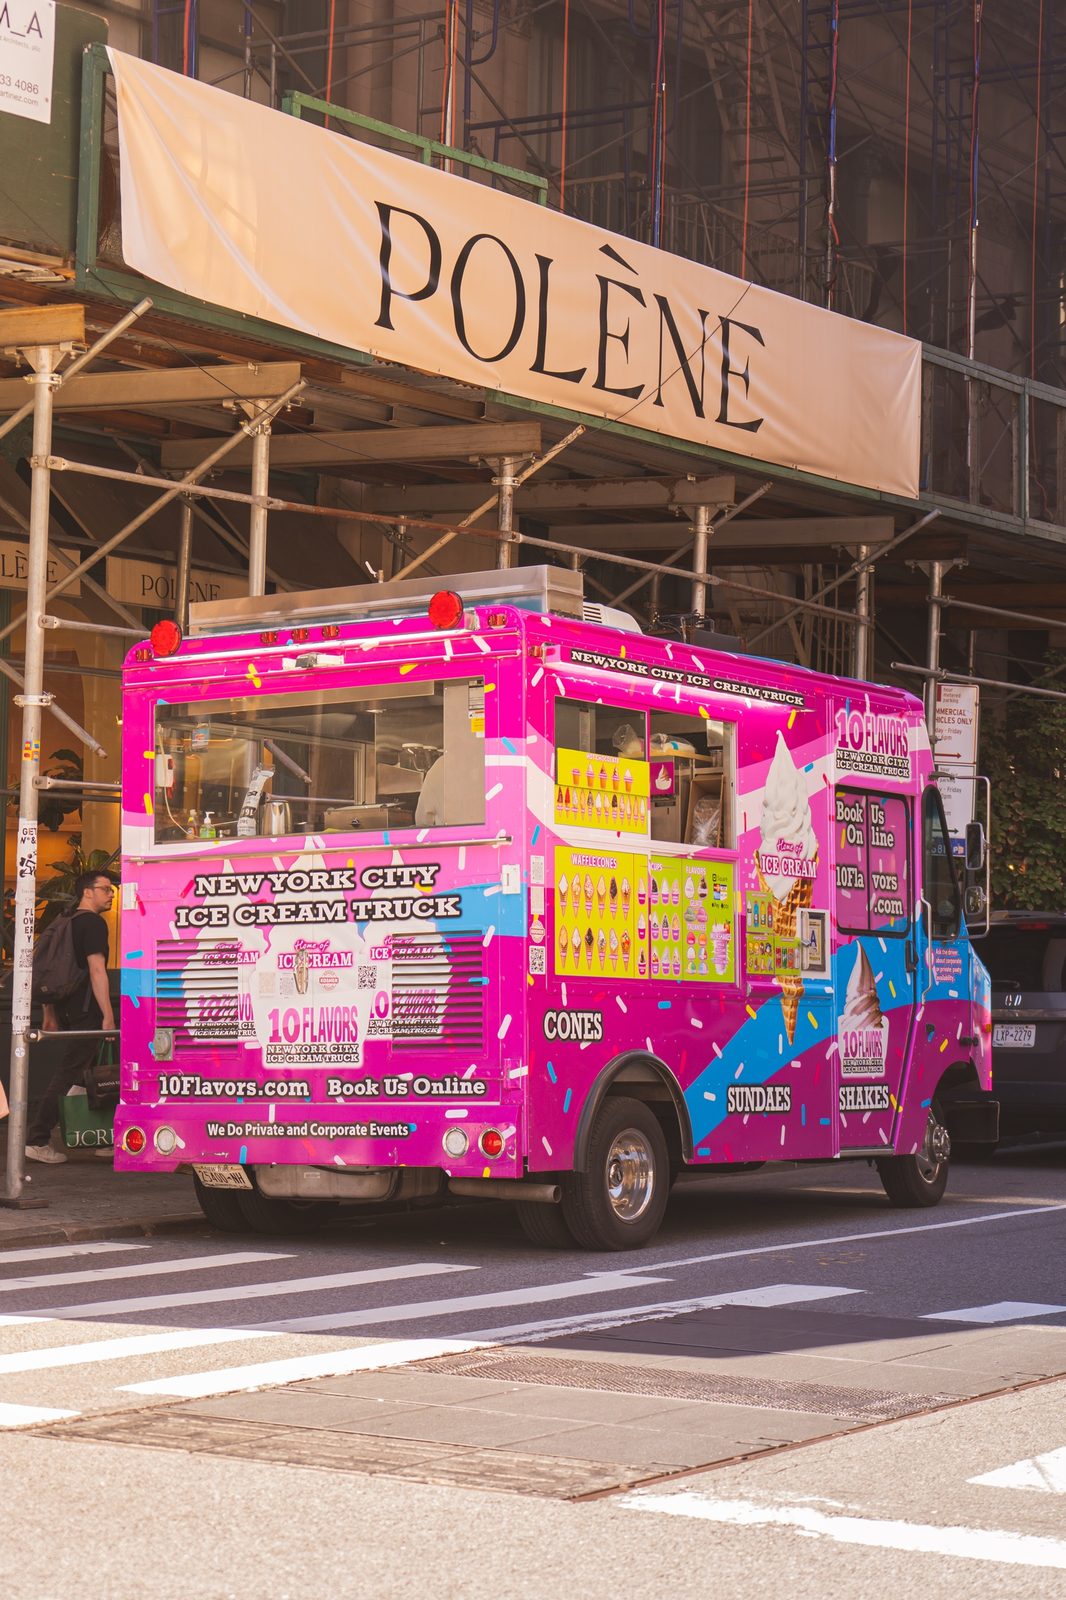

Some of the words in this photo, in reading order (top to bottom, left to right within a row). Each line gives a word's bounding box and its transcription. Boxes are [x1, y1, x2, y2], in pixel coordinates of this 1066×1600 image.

[15, 79, 39, 95] 4086
[374, 201, 765, 433] POLÈNE
[1, 550, 58, 584] LÈE
[141, 574, 221, 602] POLNE
[571, 651, 605, 665] NEW
[607, 658, 648, 674] YORK
[651, 668, 684, 681] CITY
[687, 675, 711, 687] ICE
[713, 680, 760, 697] CREAM
[762, 690, 804, 705] TRUCK
[957, 717, 973, 725] ONLY
[836, 712, 864, 751] 10
[864, 715, 909, 758] FLAVORS
[836, 760, 851, 769] ICE
[853, 762, 882, 773] CREAM
[883, 766, 909, 777] TRUCK
[837, 750, 858, 760] NEW
[860, 753, 885, 764] YORK
[887, 757, 909, 768] CITY
[836, 800, 864, 822] Book
[871, 804, 885, 825] Us
[847, 824, 864, 845] On
[871, 826, 894, 847] line
[571, 853, 597, 866] WAFFLE
[597, 856, 617, 869] CONES
[761, 856, 780, 874] ICE
[781, 857, 817, 878] CREAM
[195, 874, 265, 895] NEW
[266, 870, 355, 892] YORK
[361, 866, 439, 887] CITY
[836, 866, 864, 888] 10Fla
[872, 874, 898, 891] vors
[177, 907, 228, 926] ICE
[234, 902, 347, 924] CREAM
[352, 897, 461, 920] TRUCK
[874, 899, 903, 915] .com
[294, 939, 317, 950] Home
[319, 940, 330, 951] of
[811, 930, 817, 947] A
[307, 952, 353, 967] CREAM
[371, 948, 389, 959] ICE
[267, 1007, 301, 1043] 10
[302, 1005, 358, 1043] FLAVORS
[544, 1011, 603, 1040] CONES
[267, 1045, 292, 1054] NEW
[293, 1045, 327, 1054] YORK
[329, 1044, 359, 1053] CITY
[267, 1055, 285, 1063] ICE
[286, 1054, 321, 1062] CREAM
[322, 1054, 359, 1062] TRUCK
[160, 1076, 310, 1096] 10Flavors.com
[327, 1079, 379, 1096] Book
[384, 1079, 408, 1096] Us
[413, 1077, 486, 1096] Online
[727, 1086, 791, 1112] SUNDAES
[839, 1085, 889, 1111] SHAKES
[67, 1129, 115, 1147] J.CR
[207, 1123, 225, 1136] We
[227, 1123, 243, 1136] Do
[245, 1123, 284, 1136] Private
[286, 1123, 308, 1136] and
[310, 1123, 368, 1138] Corporate
[370, 1123, 409, 1136] Events
